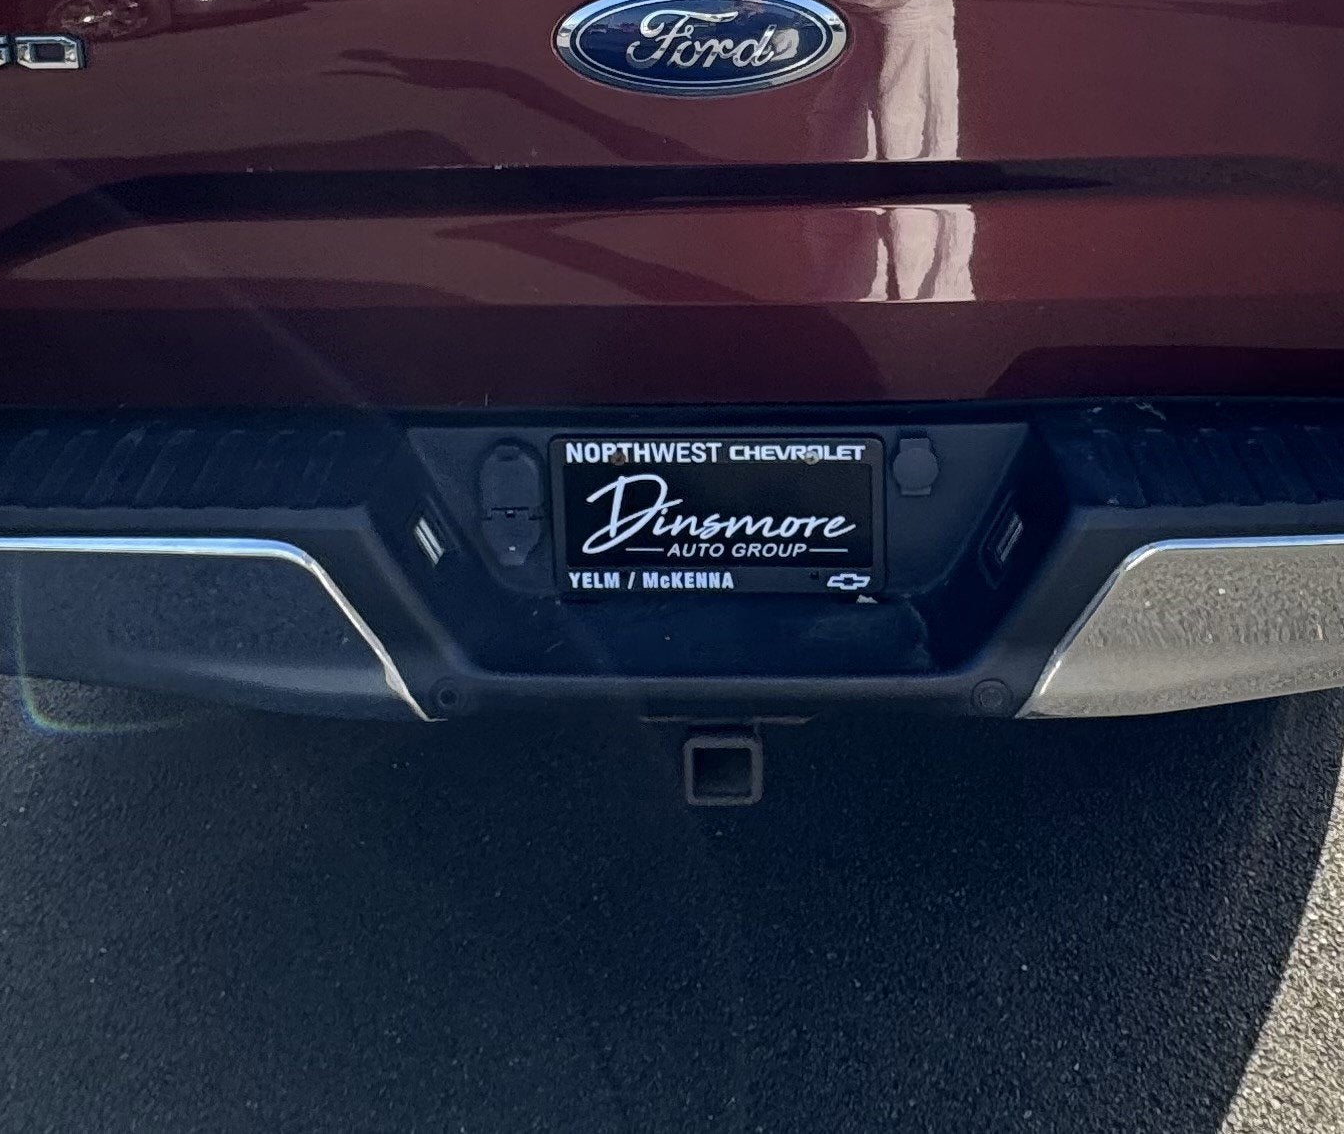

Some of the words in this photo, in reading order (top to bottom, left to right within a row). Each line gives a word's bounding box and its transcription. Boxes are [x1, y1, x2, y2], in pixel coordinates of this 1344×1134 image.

[626, 9, 774, 68] Ford
[565, 442, 723, 464] NORTHWEST
[729, 445, 866, 462] CHEVROLET
[582, 474, 857, 555] Dinsmore
[667, 543, 725, 558] AUTO
[731, 543, 807, 558] GROUP
[569, 572, 620, 590] YELM
[627, 572, 636, 590] /
[643, 572, 734, 590] McKENNA
